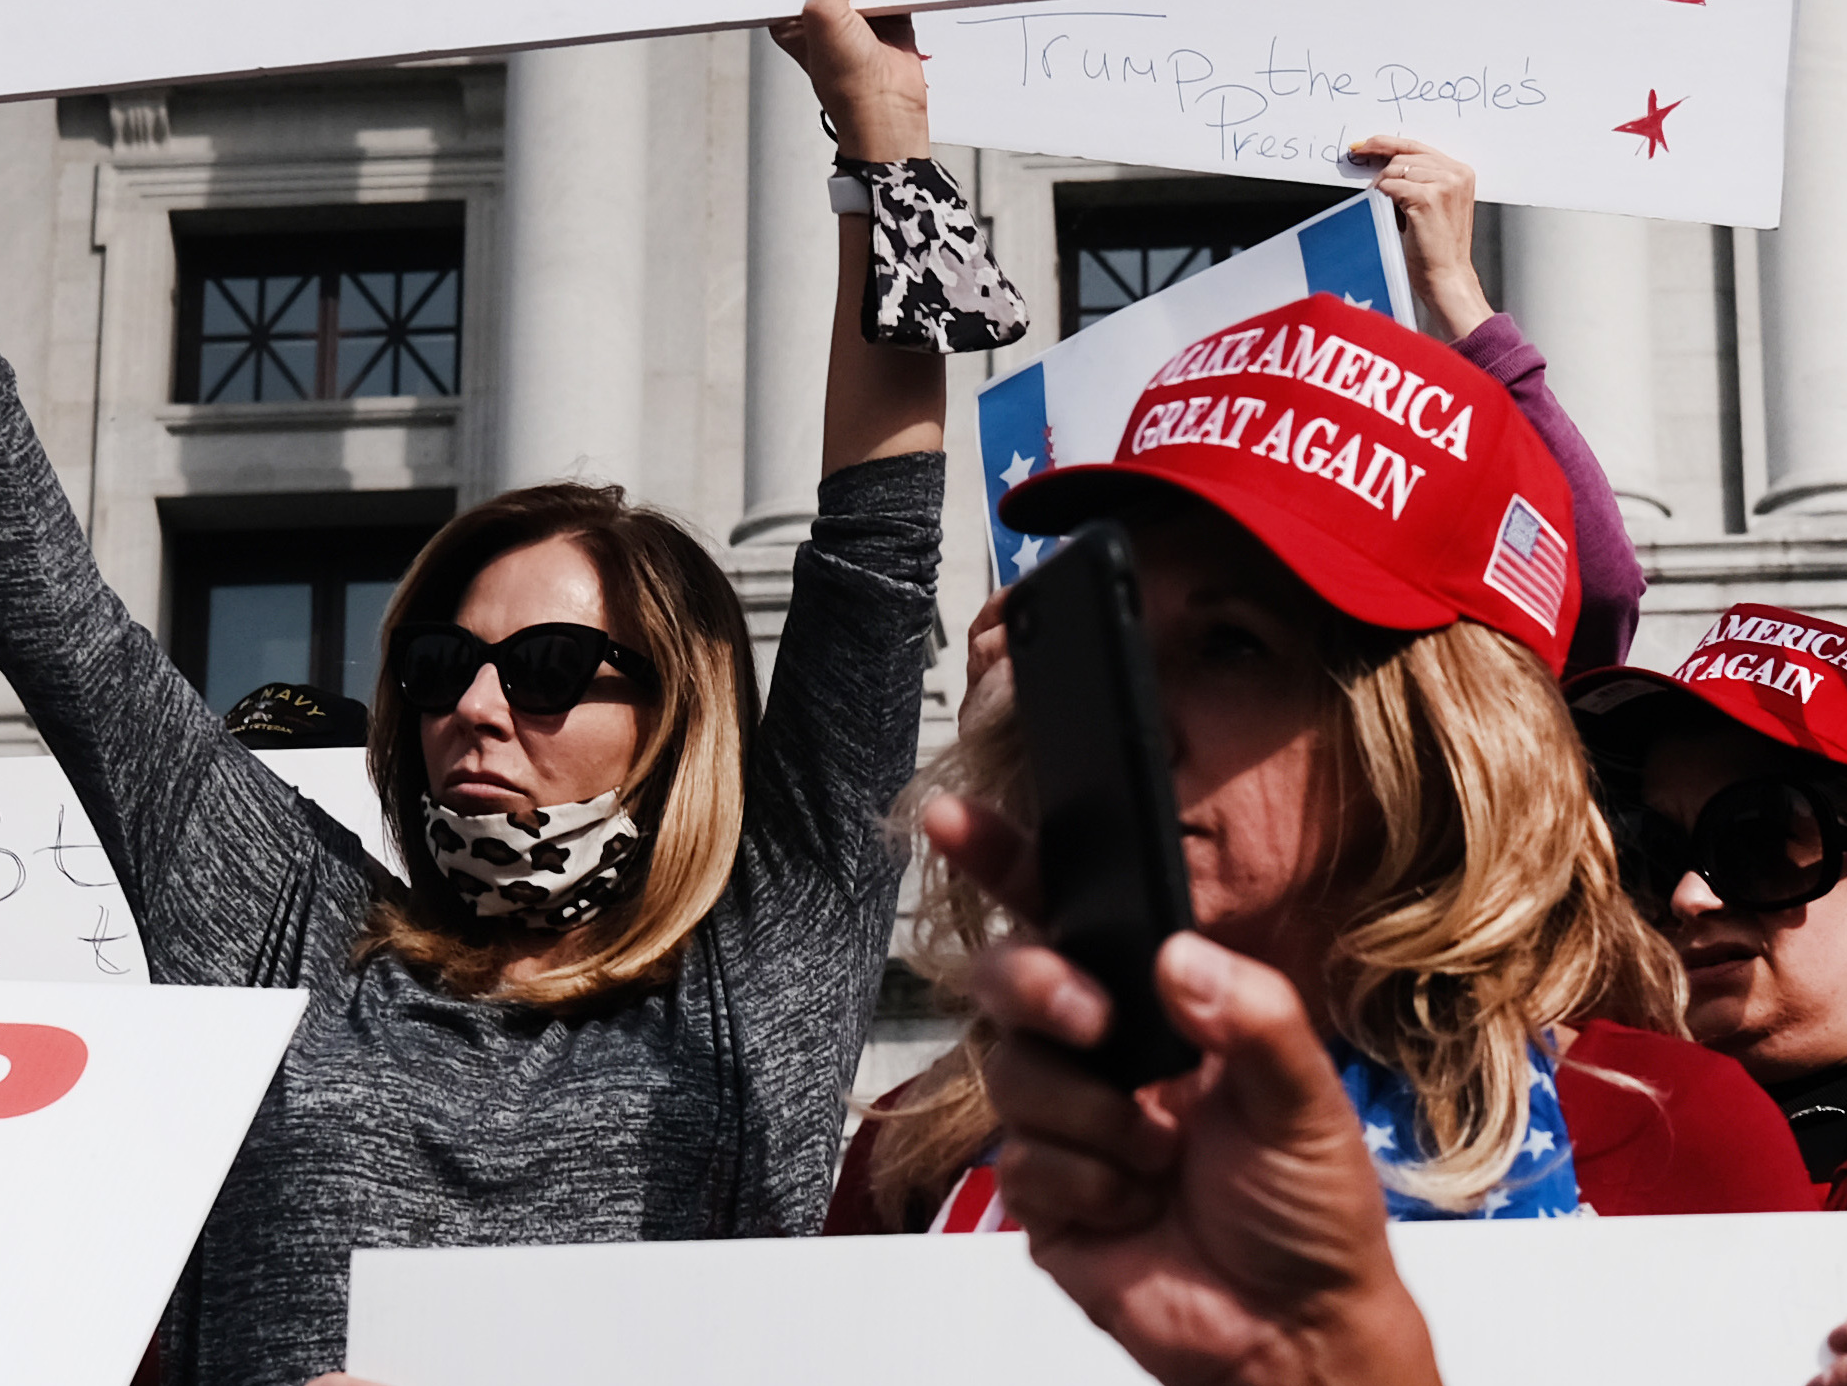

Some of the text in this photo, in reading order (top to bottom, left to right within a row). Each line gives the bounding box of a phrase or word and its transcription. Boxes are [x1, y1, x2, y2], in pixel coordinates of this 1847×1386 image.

[1254, 35, 1361, 101] the
[1247, 323, 1473, 463] AMERICA
[1131, 394, 1426, 522] GREAT AGAIN
[259, 686, 327, 717] NAVY
[1696, 652, 1825, 705] AGAIN
